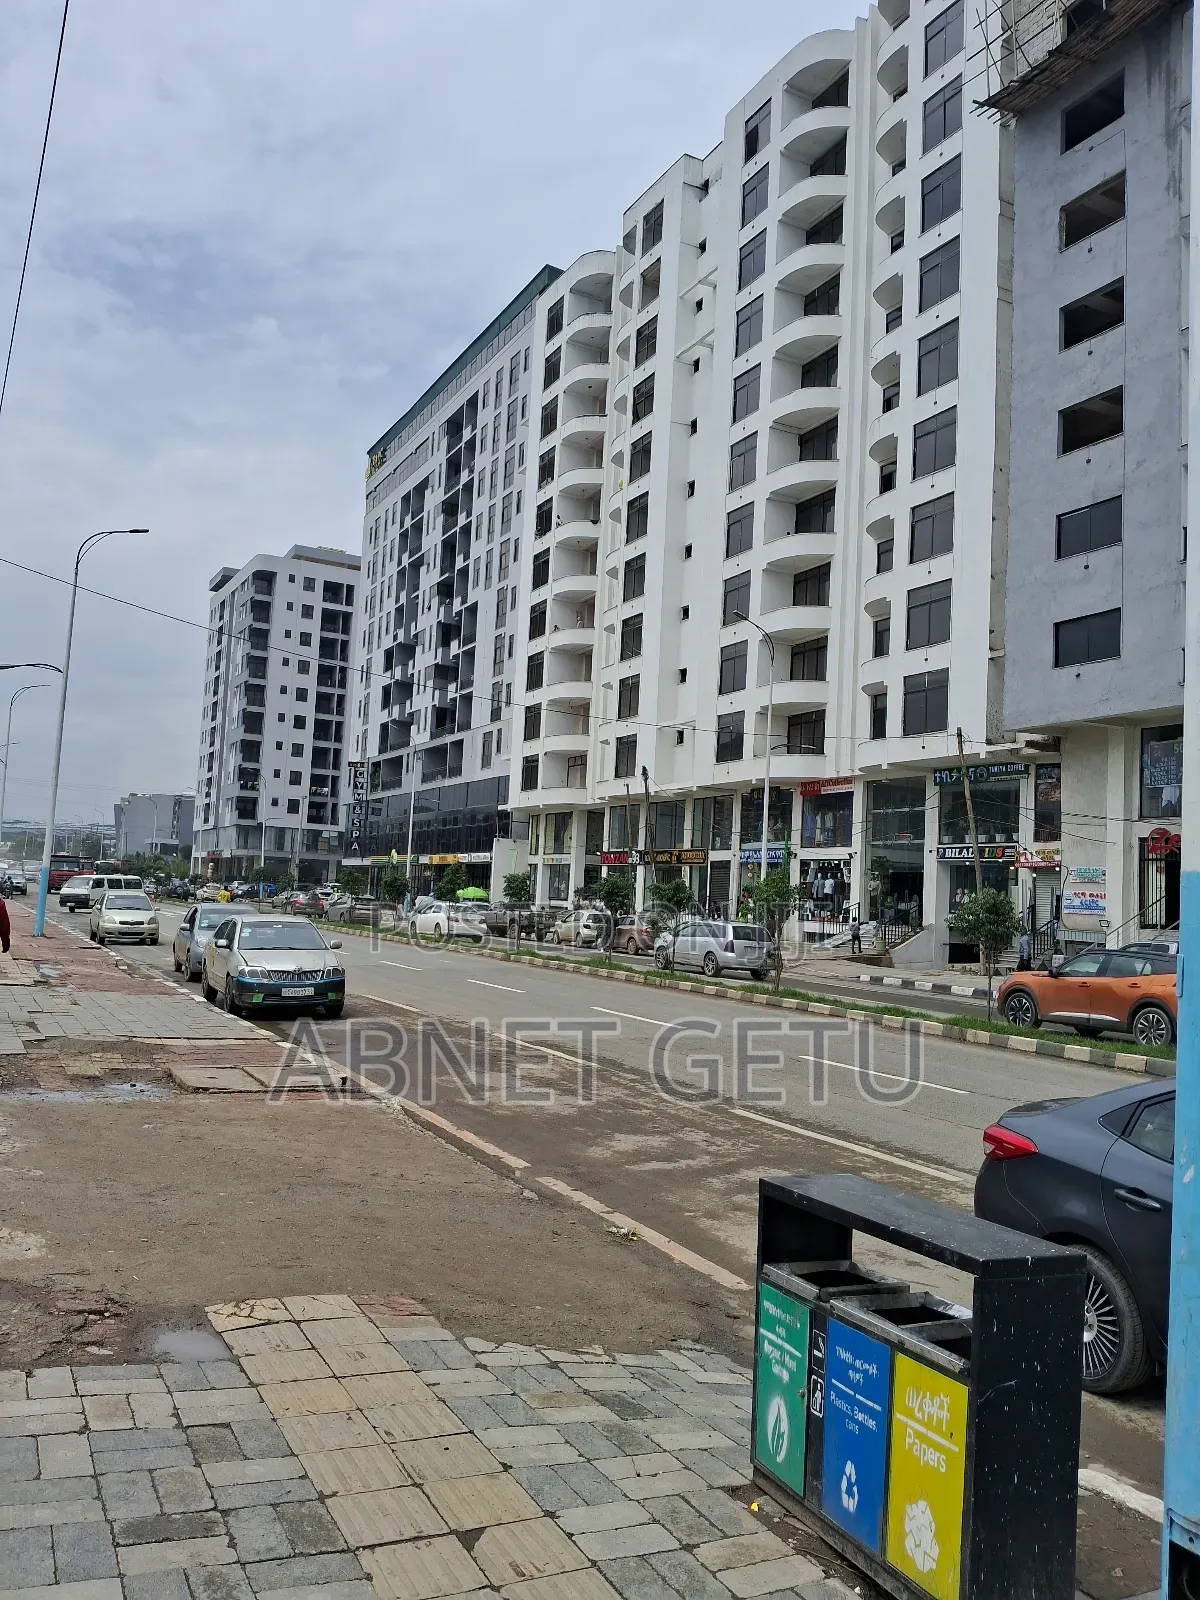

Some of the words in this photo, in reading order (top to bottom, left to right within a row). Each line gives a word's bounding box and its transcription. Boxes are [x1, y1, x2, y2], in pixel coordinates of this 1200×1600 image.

[1007, 763, 1025, 772] COFFEE
[354, 770, 364, 801] GYM
[351, 819, 360, 850] SPA
[944, 847, 975, 858] BILAL
[905, 1427, 946, 1472] Papers
